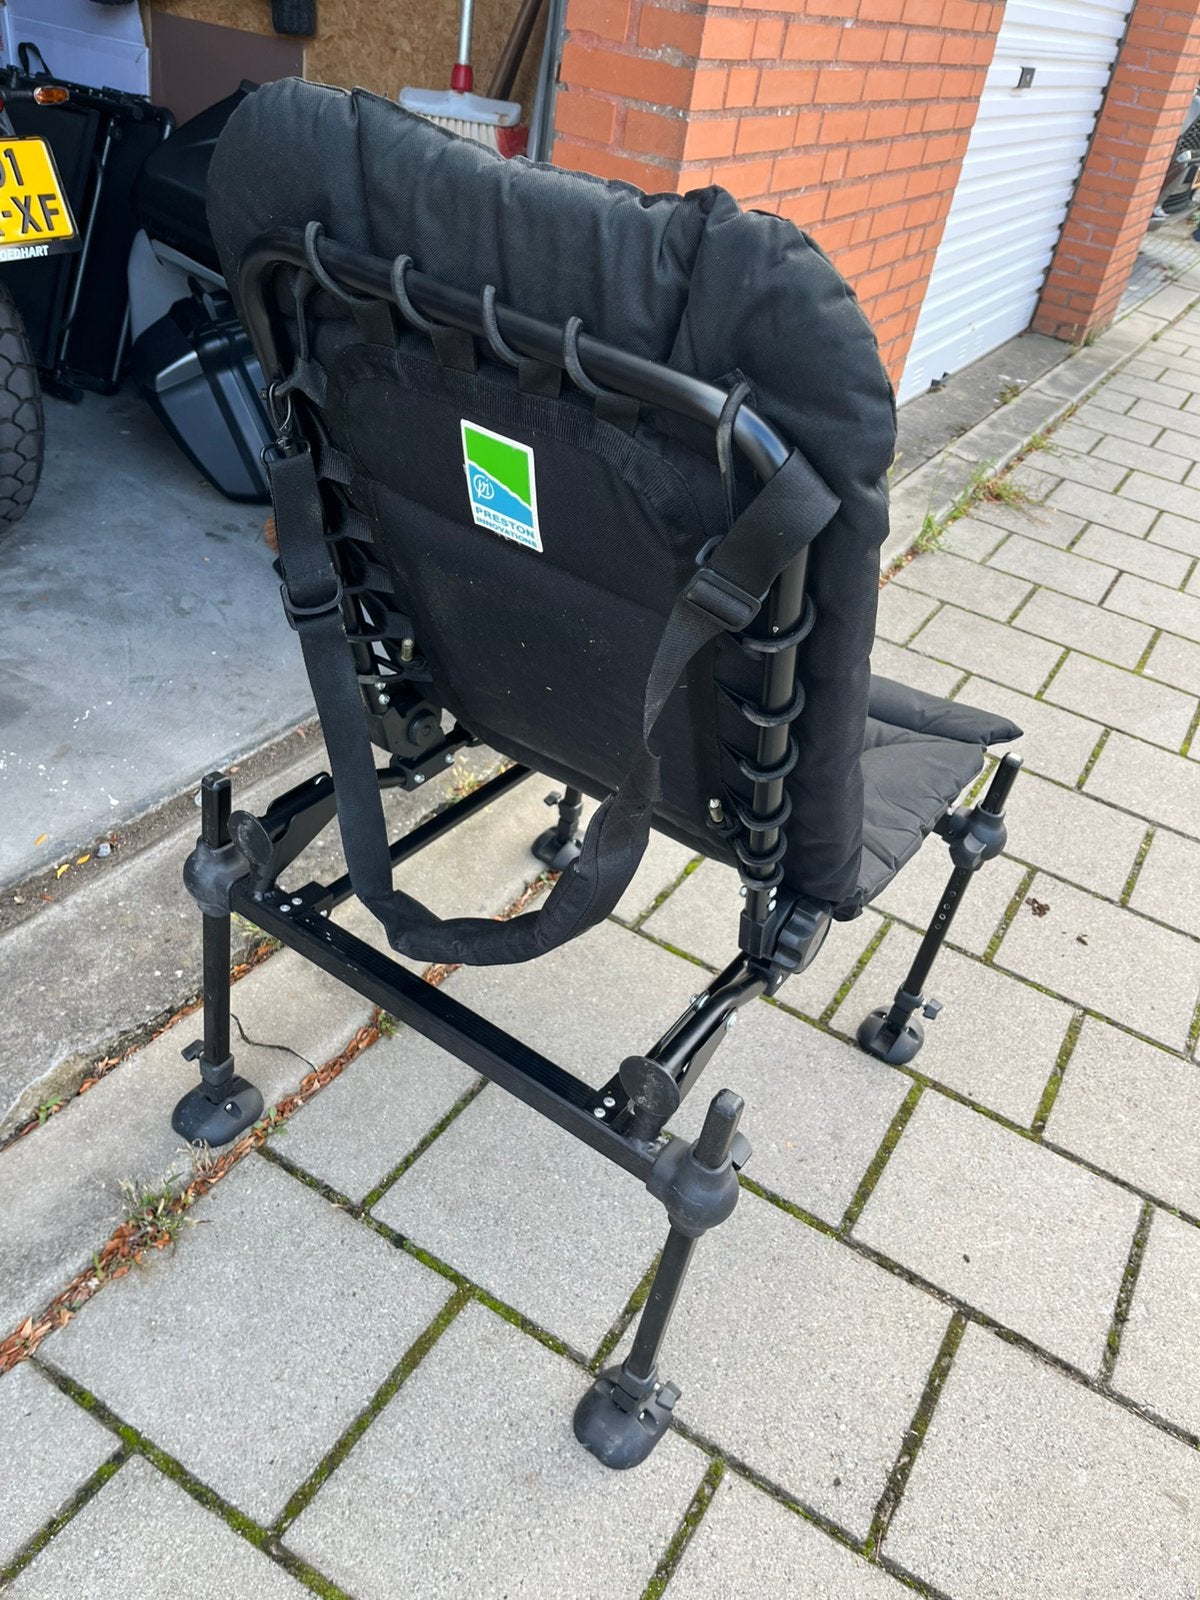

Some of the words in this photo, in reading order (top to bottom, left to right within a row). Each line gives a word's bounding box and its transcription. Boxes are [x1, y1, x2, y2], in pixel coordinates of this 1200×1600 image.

[0, 194, 59, 236] -XF
[475, 506, 535, 539] PRESTON
[476, 516, 537, 548] INNOVATIONS
